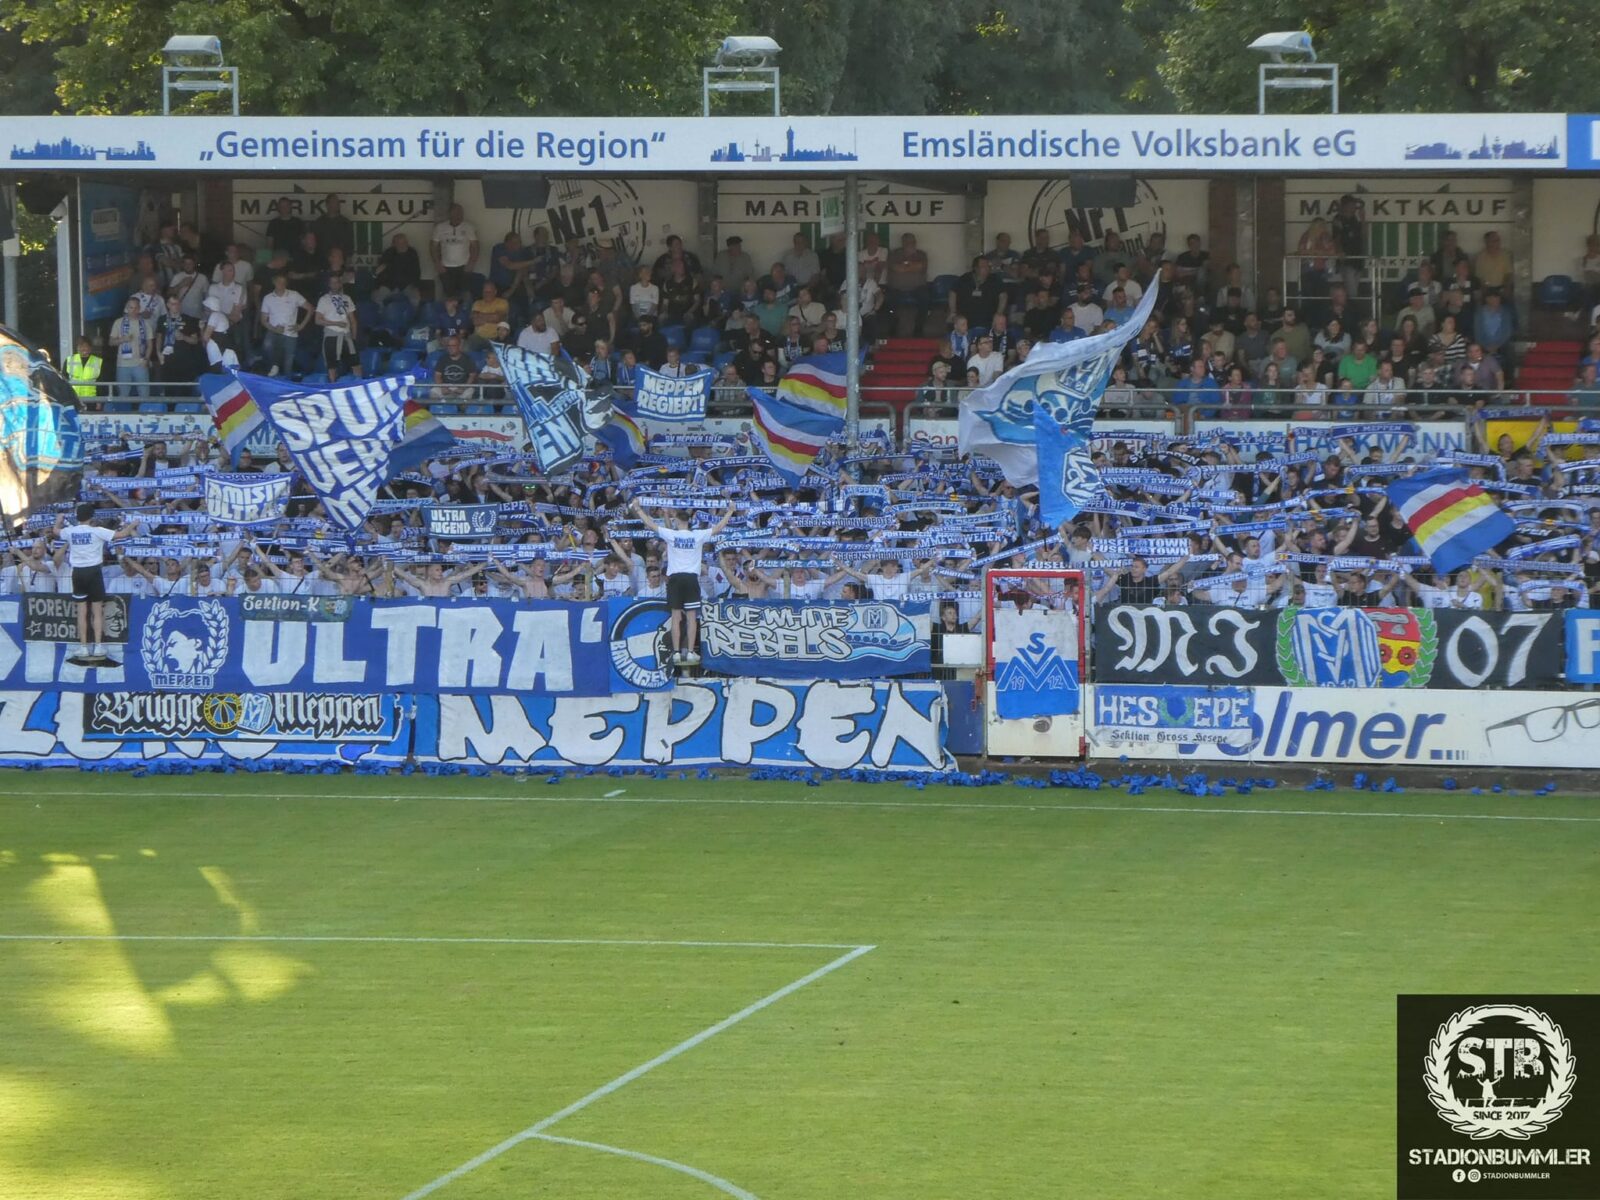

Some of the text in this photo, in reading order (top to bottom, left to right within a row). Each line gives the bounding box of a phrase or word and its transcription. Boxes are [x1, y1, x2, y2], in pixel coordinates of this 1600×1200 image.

[200, 129, 665, 165] „Gemeinsam für die Region“
[902, 129, 1356, 158] Emsländische Volksbank eG
[643, 373, 705, 394] MEPPEN
[637, 396, 706, 414] REGIERT!
[1106, 499, 1126, 510] 1912
[1169, 503, 1189, 515] 1912
[430, 509, 467, 522] ULTRA
[430, 522, 472, 535] JUGEND
[701, 602, 851, 629] BLUE WHITE
[701, 620, 853, 661] REBELS
[155, 674, 211, 687] MEPPEN
